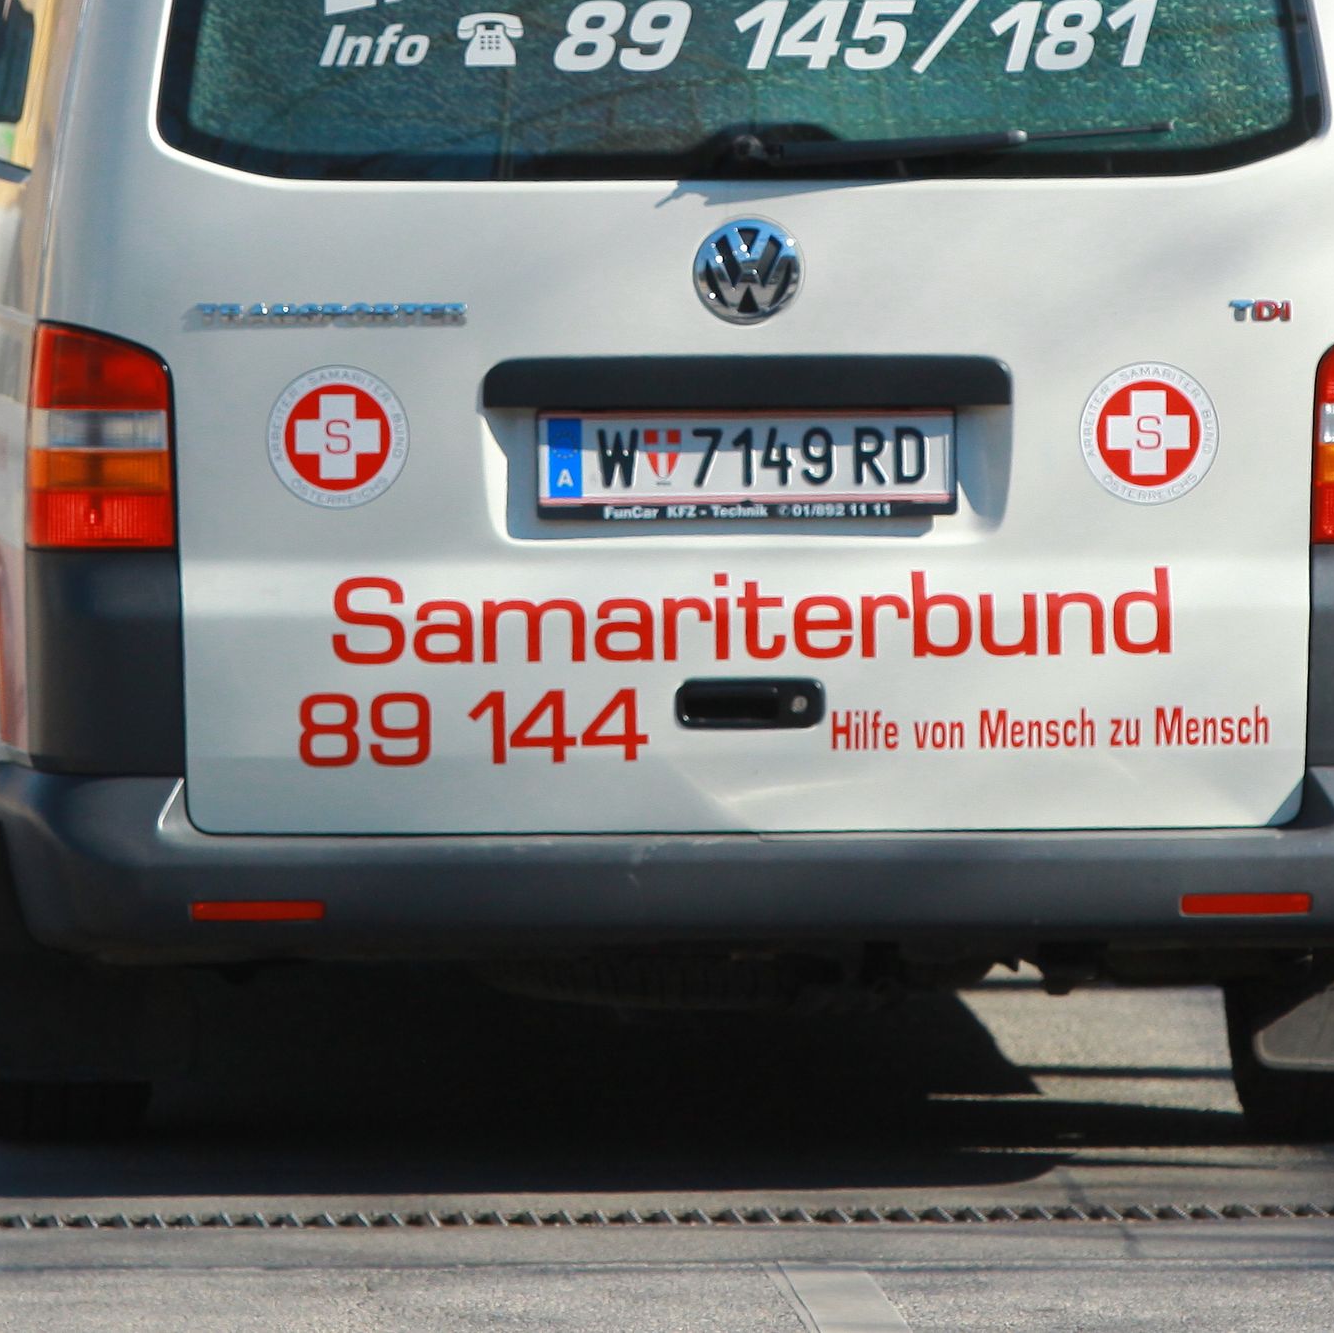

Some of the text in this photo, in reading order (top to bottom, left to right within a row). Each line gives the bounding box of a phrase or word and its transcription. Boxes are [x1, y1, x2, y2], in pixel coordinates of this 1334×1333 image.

[319, 22, 431, 67] Info
[553, 0, 693, 73] 89
[1228, 298, 1292, 322] TDI
[325, 419, 351, 455] S
[1136, 415, 1162, 450] S
[556, 426, 925, 488] A W 7149 RD
[603, 505, 659, 520] FunCar
[667, 504, 696, 518] KFZ
[712, 503, 768, 518] Technik
[850, 502, 868, 517] 11
[873, 502, 892, 517] 11
[331, 566, 1173, 667] Samariterbund
[298, 687, 650, 769] 89 144
[831, 705, 1271, 752] Hilfe von Mensch zu Mensch
